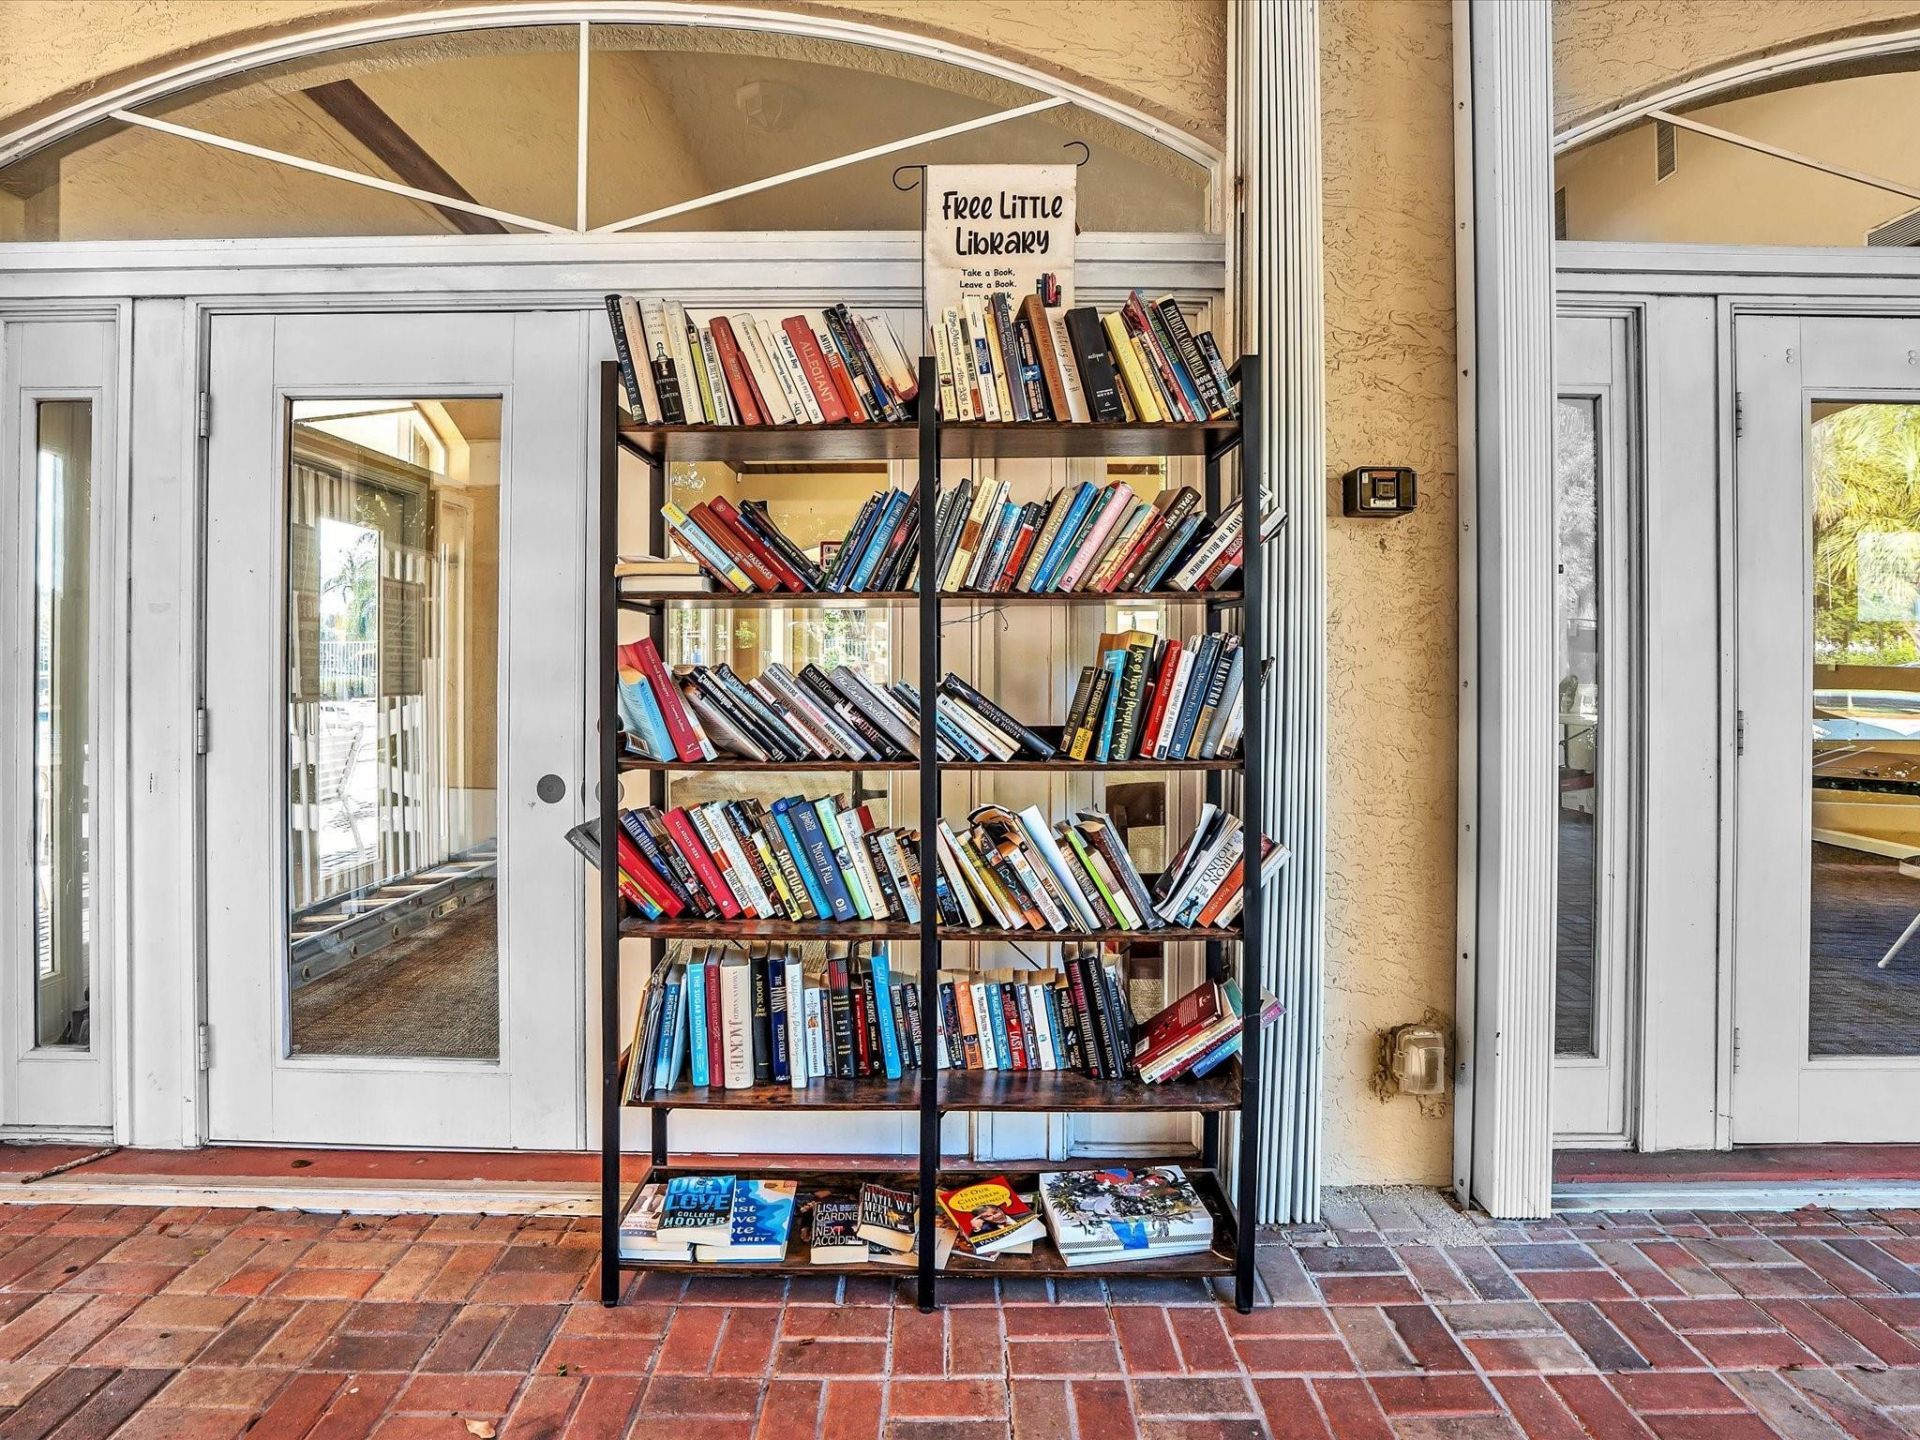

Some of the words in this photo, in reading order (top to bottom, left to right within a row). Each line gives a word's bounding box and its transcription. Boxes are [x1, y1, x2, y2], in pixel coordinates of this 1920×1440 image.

[960, 280, 983, 288] Leave
[995, 280, 1017, 288] Book.
[961, 268, 982, 277] Take
[993, 268, 1016, 277] Book,
[780, 335, 789, 346] The
[784, 345, 795, 359] Lost
[1049, 318, 1070, 359] Melting
[1062, 362, 1076, 383] Love
[1162, 304, 1189, 339] PATRICIA
[1178, 336, 1207, 377] CORNWELL
[616, 337, 628, 364] ANNE
[624, 369, 637, 399] TYLER
[789, 357, 799, 369] Boy
[799, 338, 835, 405] ALLEGIANT
[1194, 372, 1212, 385] BOOK
[1201, 387, 1218, 399] DEAD
[1177, 491, 1193, 510] OPAL
[1163, 513, 1176, 529] NEV
[1216, 531, 1228, 543] THE
[746, 552, 773, 579] PASSAGES
[1188, 552, 1209, 576] NOWHERE
[1134, 648, 1145, 663] Age
[1132, 664, 1143, 673] of
[767, 666, 797, 697] BLOCKBUSTERS
[804, 666, 823, 684] Carol
[817, 679, 845, 706] O'Connell
[833, 671, 851, 688] The
[845, 682, 865, 701] Cave
[1129, 673, 1142, 690] Vice
[1190, 671, 1204, 701] WOODEN
[1207, 661, 1230, 705] MAESTRO
[975, 695, 995, 711] CAROL
[1120, 700, 1137, 727] Deepti
[823, 722, 836, 735] ANITA
[976, 703, 1000, 723] WINTER
[999, 721, 1021, 739] HOUSE
[1178, 717, 1189, 739] SONGS
[1073, 735, 1082, 749] CLUB
[1074, 729, 1088, 756] MEPHISTO
[1115, 727, 1132, 759] Kapoor
[623, 814, 644, 838] KAREN
[635, 831, 658, 858] ROBARDS
[675, 820, 683, 830] ALL
[680, 829, 693, 846] ADULTS
[692, 809, 708, 830] KATHY
[702, 827, 720, 851] REICHS
[845, 817, 854, 830] The
[739, 834, 776, 887] McDERMID
[766, 862, 777, 877] VICE
[810, 841, 829, 866] NIGHT
[820, 865, 837, 884] FALL
[1200, 839, 1233, 884] HOUND
[1209, 855, 1233, 885] IRON
[725, 869, 739, 887] BARE
[733, 885, 750, 907] BONES
[775, 848, 808, 905] SANCTUARY
[998, 865, 1033, 913] DIVIDE
[1087, 959, 1099, 987] THOMAS
[1093, 987, 1104, 1010] HARRIS
[1110, 987, 1118, 1000] THE
[906, 993, 916, 1007] IRIS
[908, 1008, 921, 1044] JOHANSEN
[1078, 1012, 1093, 1040] EXECUTIVE
[1113, 1001, 1124, 1031] PROMISE
[695, 1015, 703, 1049] SOLUTION
[728, 1019, 744, 1070] JACKIE
[1009, 1030, 1021, 1051] LAST
[1098, 1014, 1110, 1045] HANNIBAL
[1104, 1046, 1115, 1068] RISING
[1084, 1040, 1098, 1068] PRIVILEGE
[670, 1176, 733, 1194] UGLY
[664, 1194, 731, 1211] LOVE
[817, 1204, 838, 1213] LISA
[864, 1191, 893, 1207] UNTIL
[896, 1200, 913, 1213] WE
[864, 1202, 889, 1216] MEET
[663, 1217, 726, 1227] HOOVER
[816, 1212, 859, 1221] GARDNE
[863, 1211, 896, 1228] AGAIN
[815, 1226, 844, 1237] NEXT
